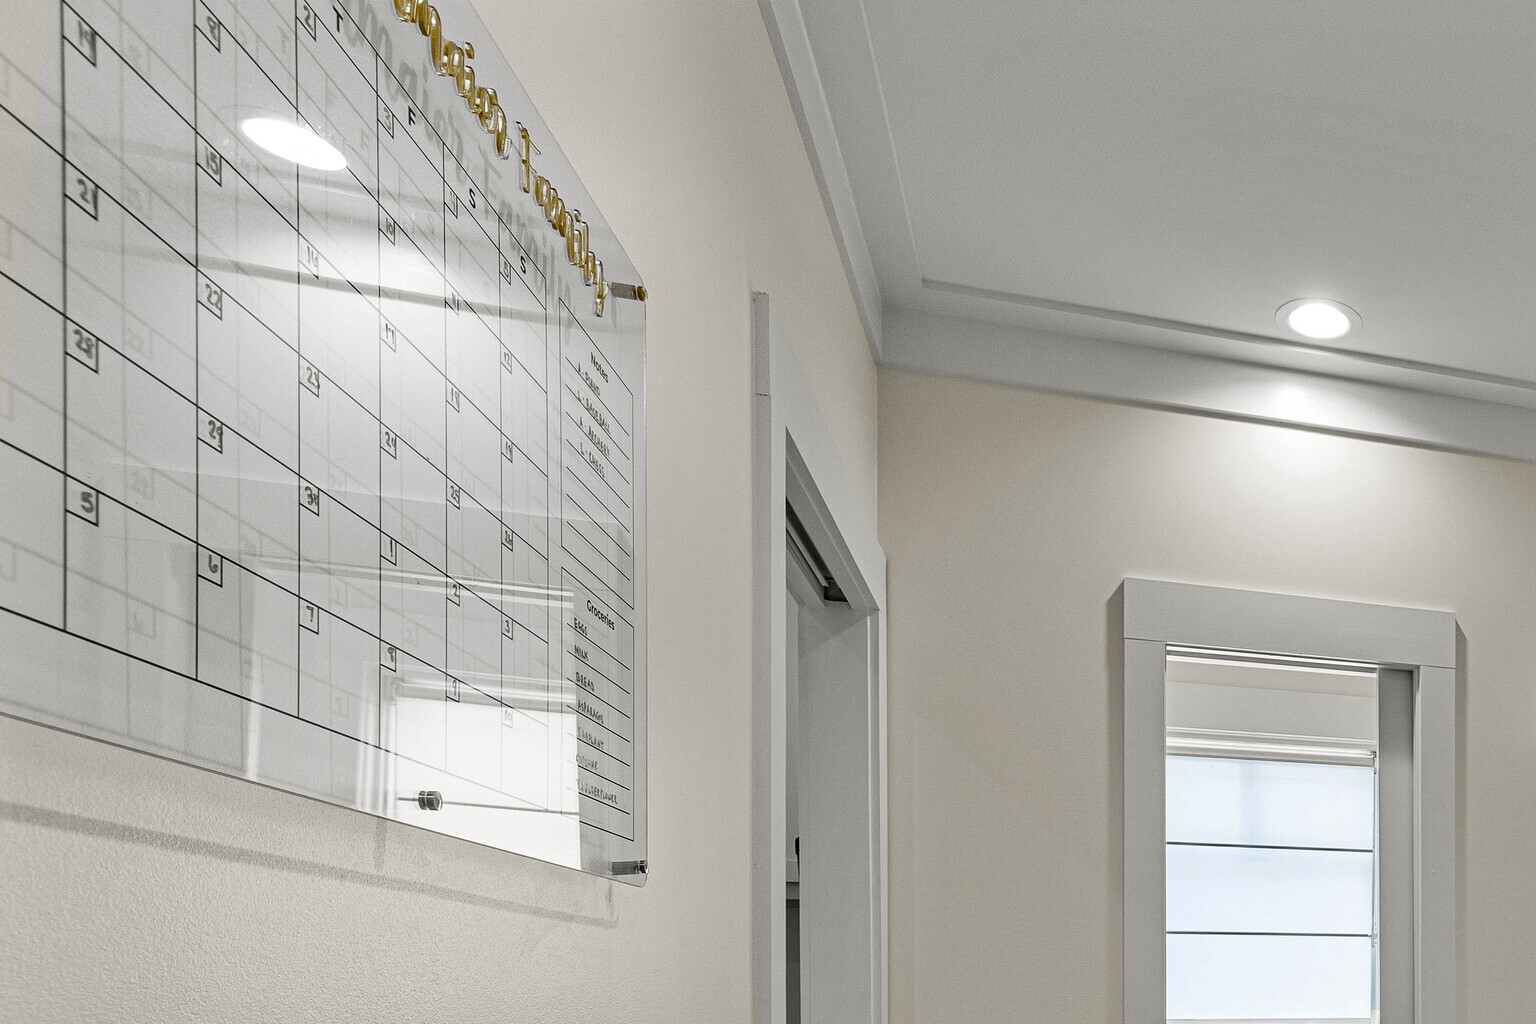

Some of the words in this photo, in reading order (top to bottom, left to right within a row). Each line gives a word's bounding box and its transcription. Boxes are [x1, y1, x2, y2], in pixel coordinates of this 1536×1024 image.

[303, 5, 314, 31] 2
[383, 106, 392, 132] 3
[332, 5, 343, 33] T
[408, 105, 417, 127] F
[468, 187, 477, 209] S
[519, 255, 527, 275] S
[205, 145, 219, 176] 15
[385, 217, 395, 236] 10
[515, 120, 608, 318] Family
[590, 351, 609, 384] Notes
[73, 328, 95, 360] 28
[205, 283, 222, 310] 22
[306, 366, 321, 390] 23
[384, 431, 397, 449] 24
[450, 485, 461, 499] 25
[80, 491, 95, 514] 5
[207, 419, 223, 449] 29
[451, 584, 460, 598] 2
[504, 619, 511, 633] 3
[208, 553, 220, 574] 6
[305, 604, 315, 623] 7
[573, 616, 588, 637] EGGS
[586, 599, 615, 631] Groceries
[574, 644, 590, 661] MILK
[575, 671, 595, 692] BREAD
